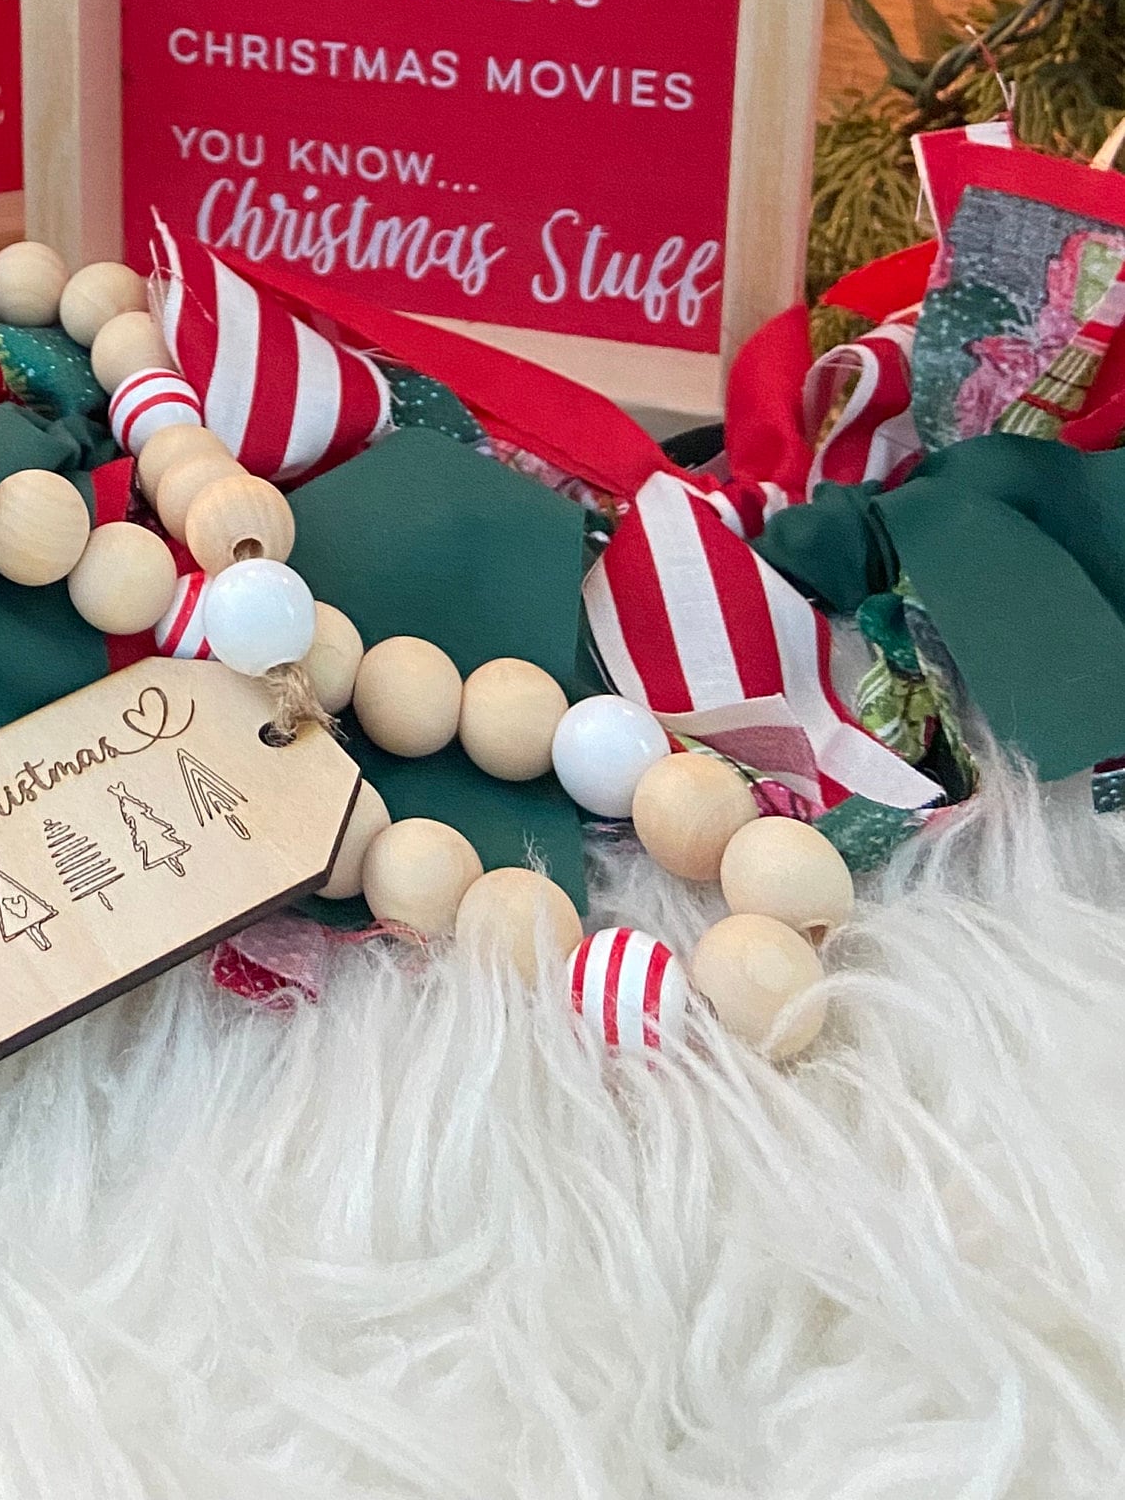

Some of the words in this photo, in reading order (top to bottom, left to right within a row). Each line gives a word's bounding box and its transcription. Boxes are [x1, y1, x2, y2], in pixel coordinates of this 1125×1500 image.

[167, 26, 460, 90] CHRISTMAS
[485, 55, 695, 112] MOVIES
[171, 124, 266, 169] YOU
[287, 137, 479, 194] KNOW...
[195, 177, 507, 296] Christmas
[530, 207, 722, 328] Stuff
